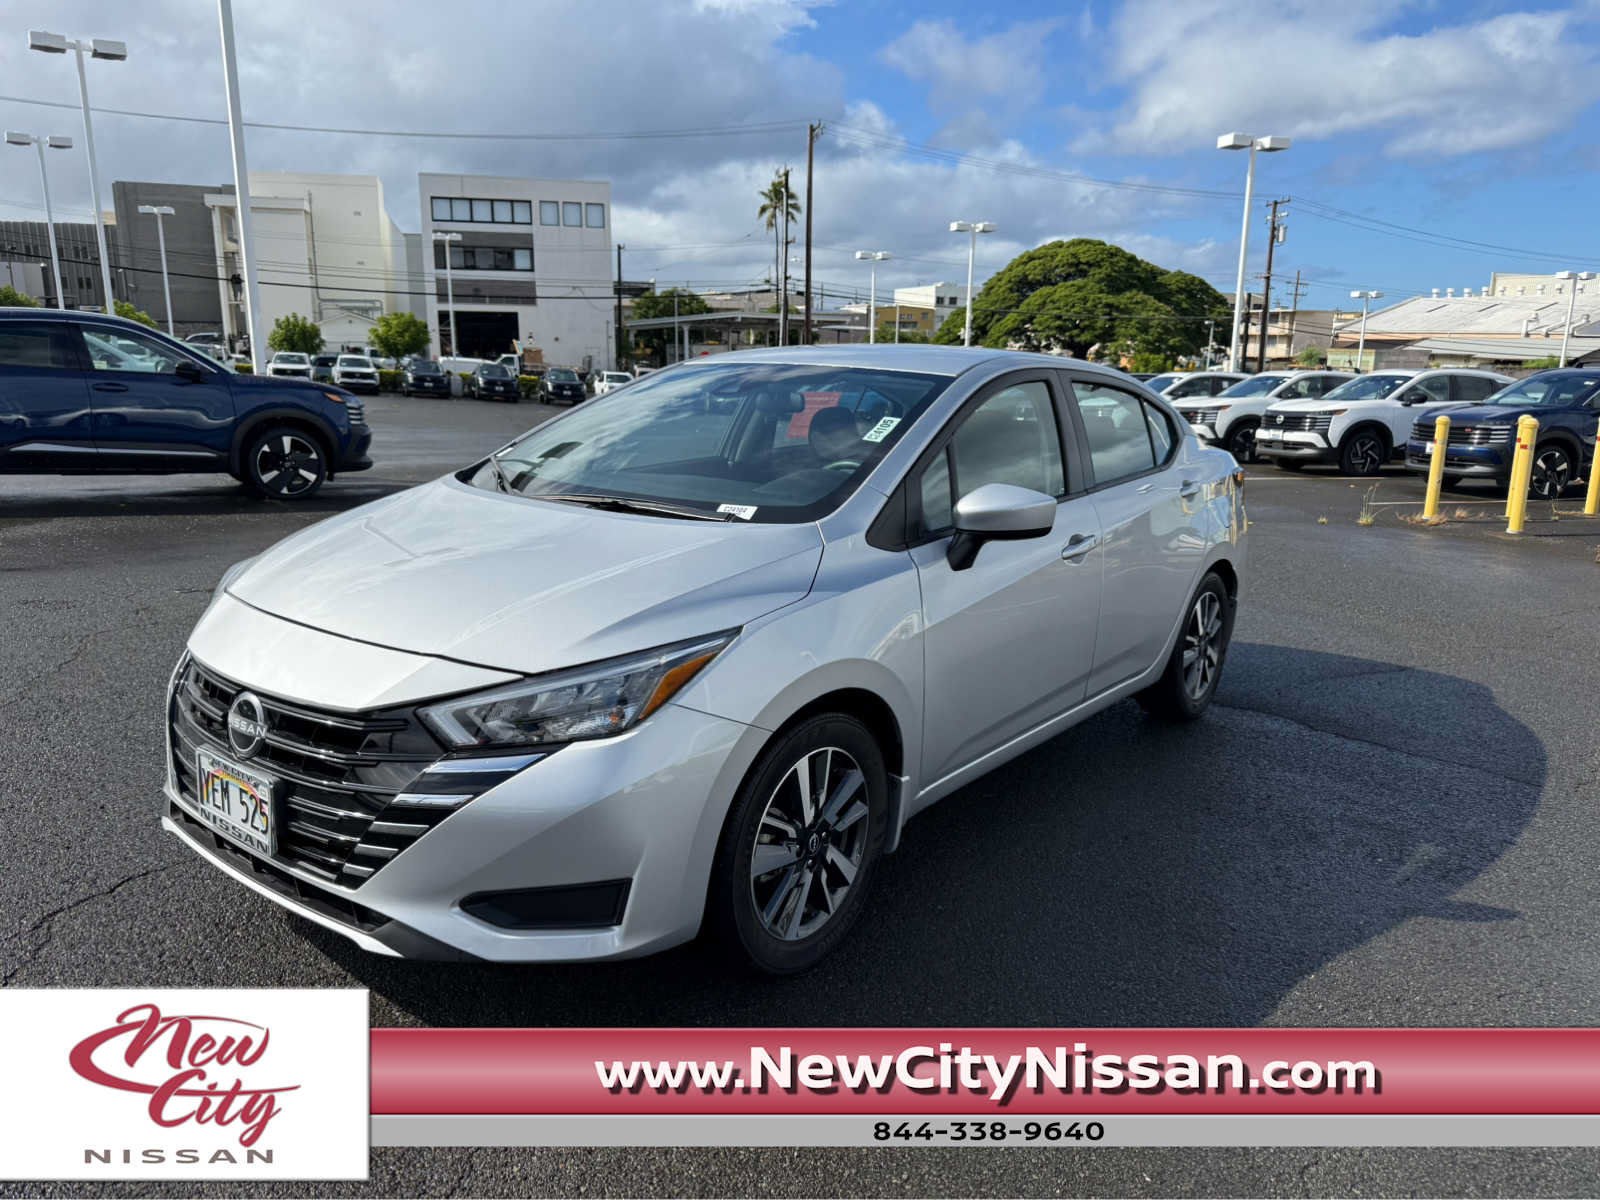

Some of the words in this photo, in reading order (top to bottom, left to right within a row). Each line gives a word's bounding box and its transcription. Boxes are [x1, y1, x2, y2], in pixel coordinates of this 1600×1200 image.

[229, 717, 265, 736] ISSAN
[202, 767, 231, 816] YEM
[239, 787, 268, 834] 525
[200, 807, 268, 853] NISSAN
